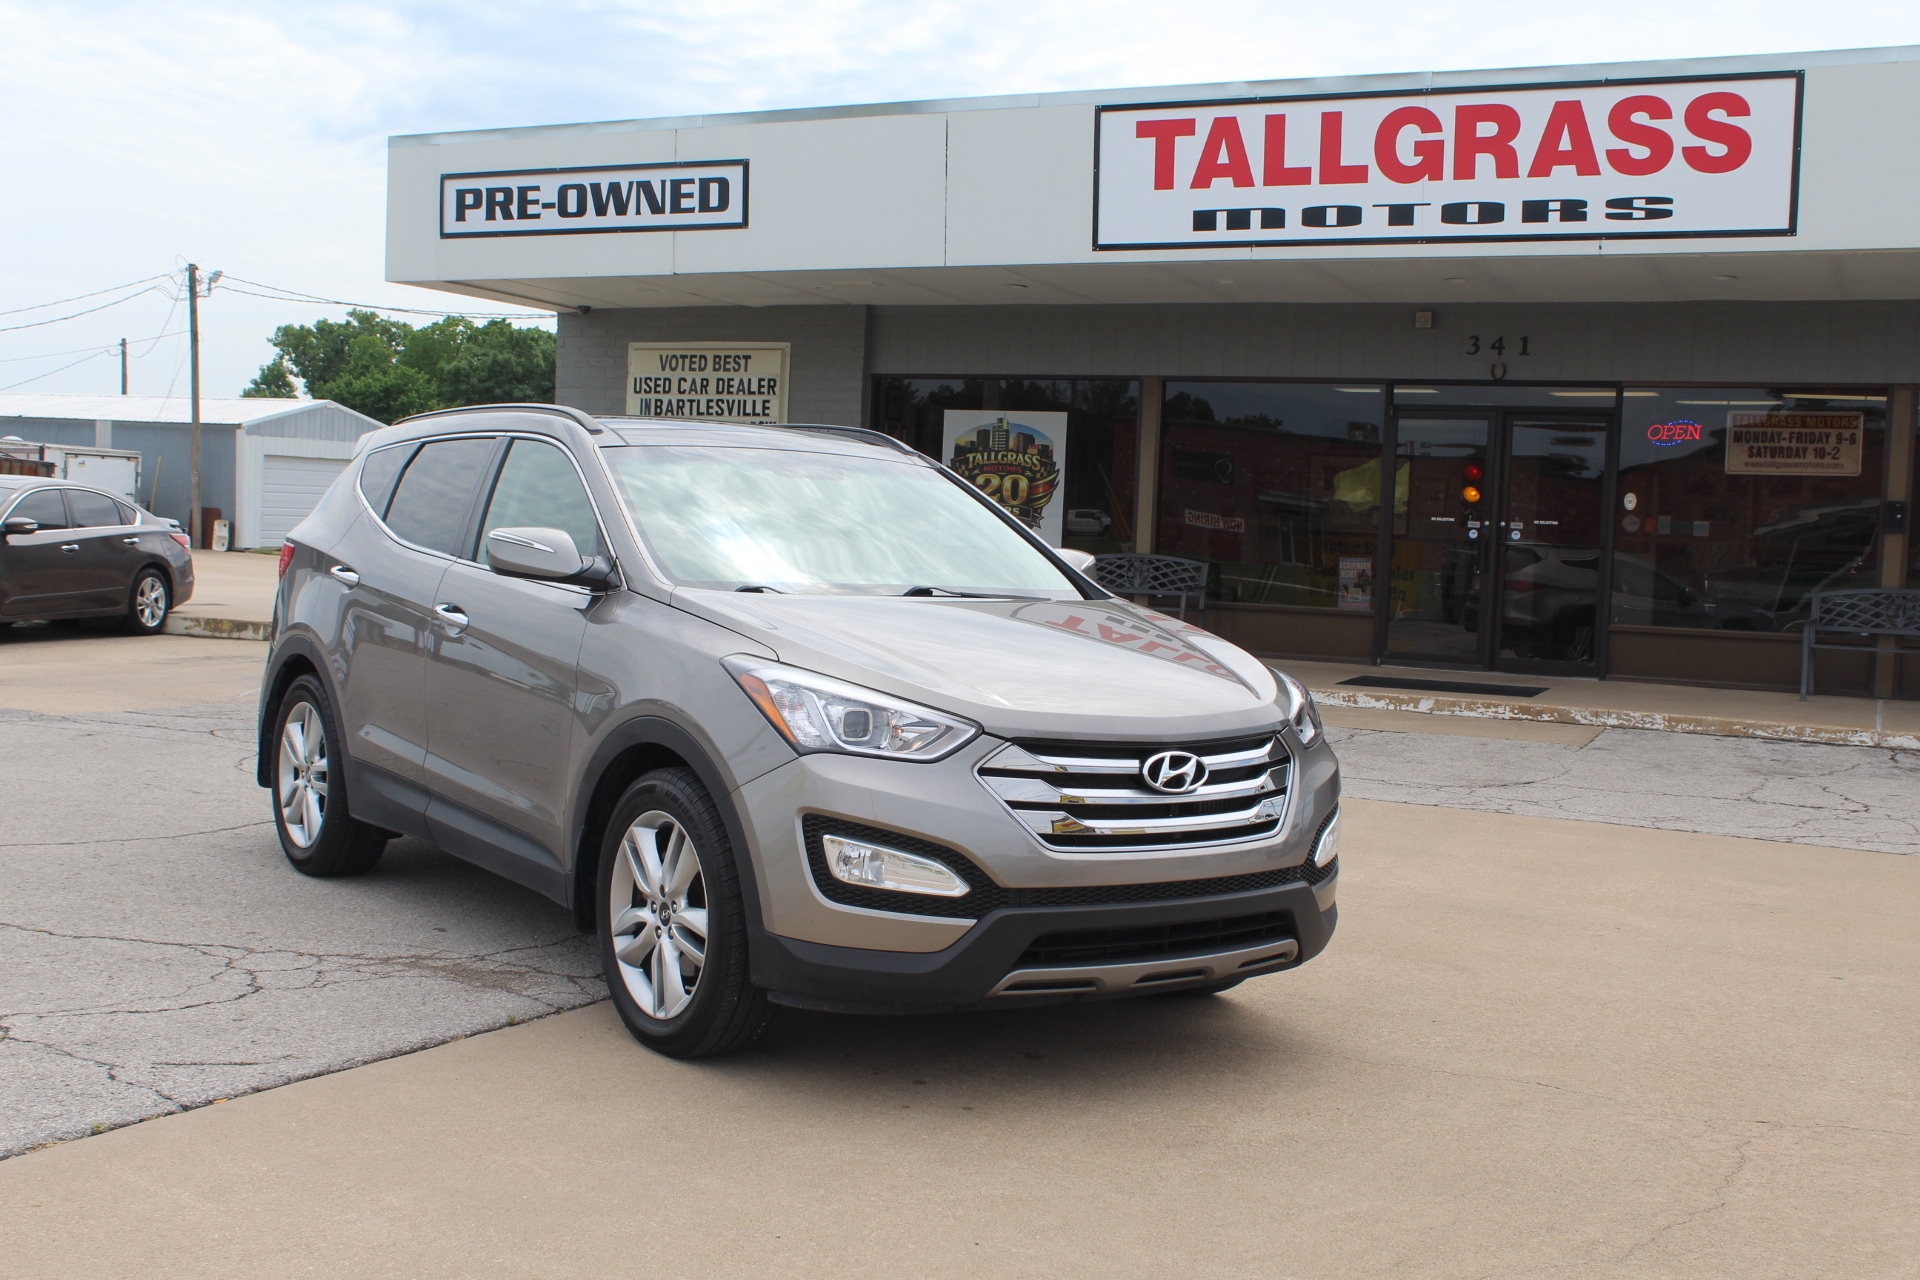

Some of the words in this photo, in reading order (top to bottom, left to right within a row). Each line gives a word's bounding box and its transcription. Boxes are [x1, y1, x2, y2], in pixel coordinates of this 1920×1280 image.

[1135, 92, 1752, 190] TALLGRASS
[455, 177, 730, 222] PRE-OWNED
[659, 354, 708, 372] VOTED
[712, 354, 752, 372] BEST
[633, 377, 672, 394] USED
[677, 377, 710, 395] CAR
[716, 377, 777, 395] DEALER
[654, 398, 770, 417] BARTLESVILLE
[1736, 416, 1801, 427] TALLGRASS
[1806, 417, 1856, 428] MOTORS
[1648, 424, 1702, 440] OPEN
[1733, 431, 1832, 445] MONDAY-FRIDAY
[1835, 432, 1857, 445] 9-6
[966, 451, 1041, 470] TALLGRASS
[1747, 445, 1808, 459] SATURDAY
[1813, 446, 1840, 460] 10-2
[983, 465, 1022, 473] MOTORS
[975, 473, 1029, 505] 20
[1341, 570, 1357, 578] HUNT
